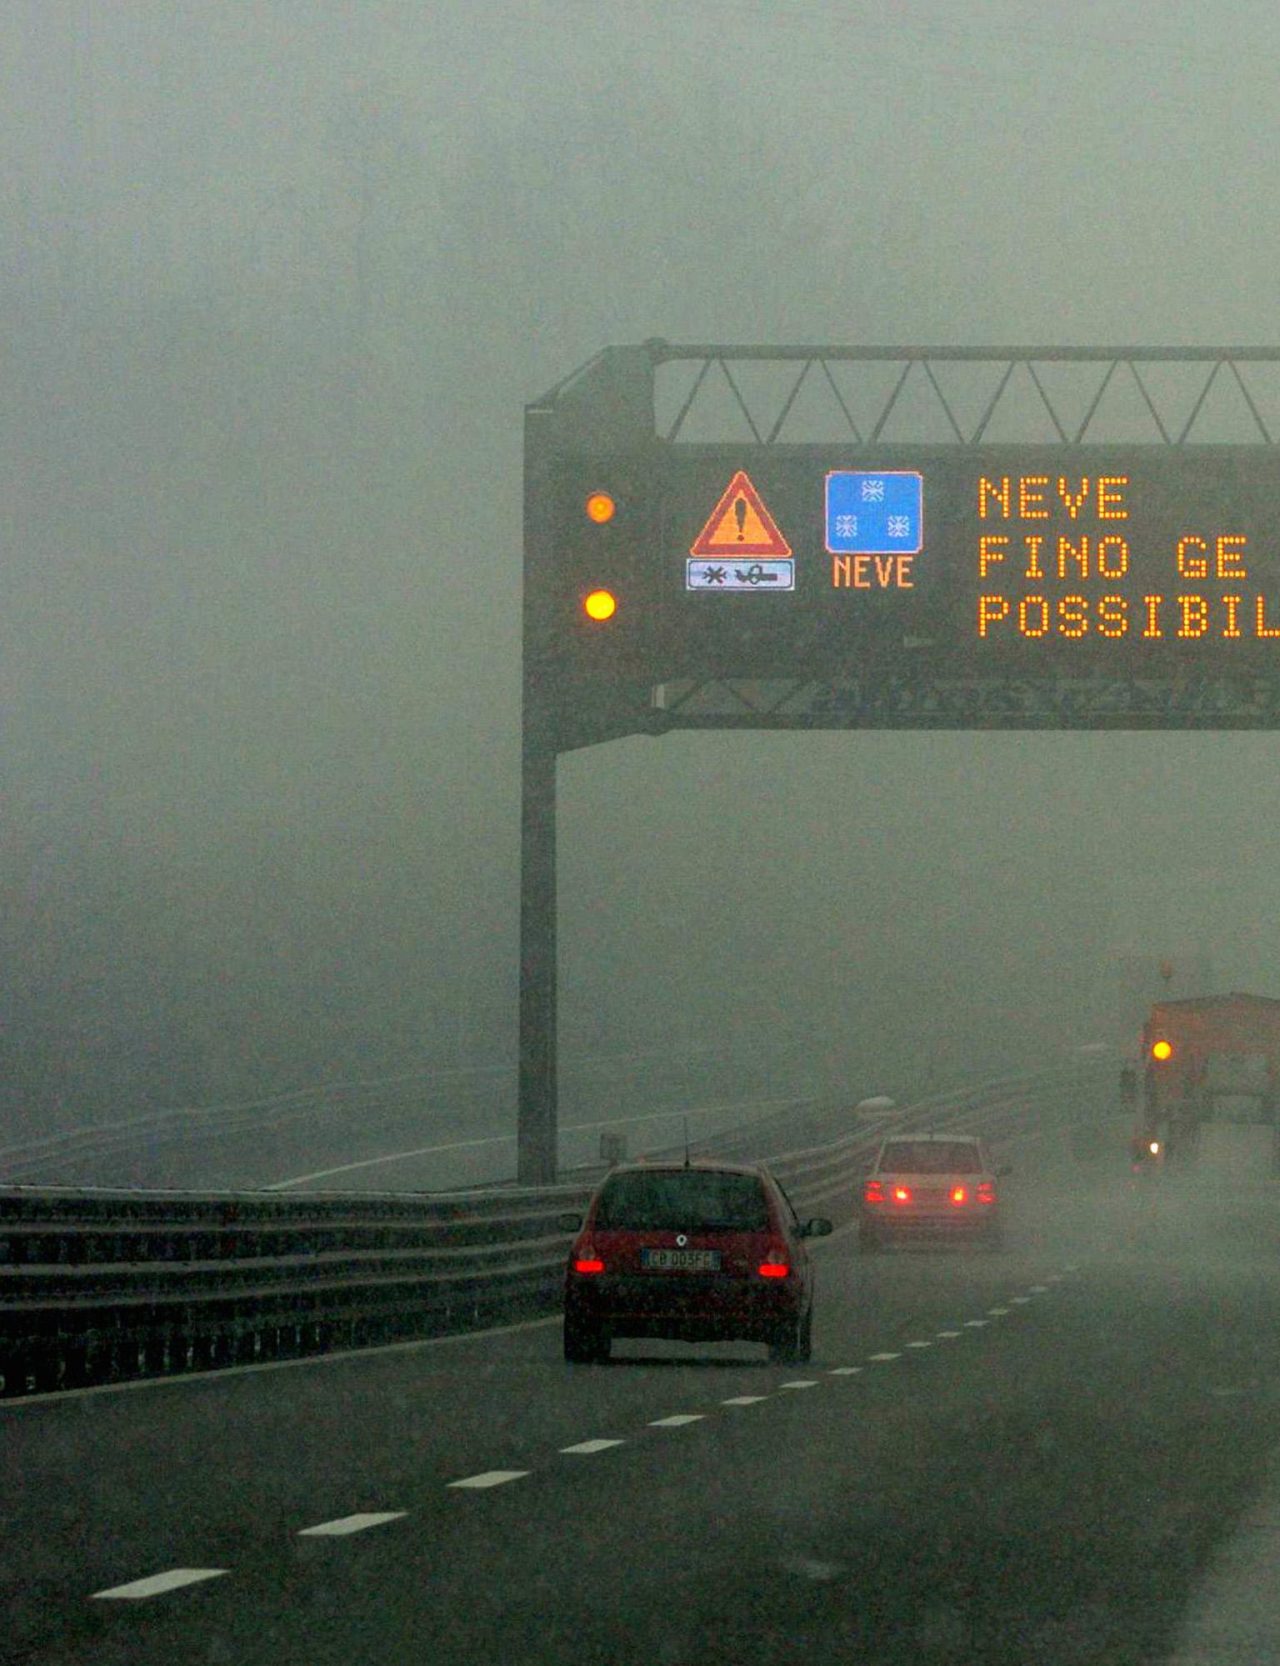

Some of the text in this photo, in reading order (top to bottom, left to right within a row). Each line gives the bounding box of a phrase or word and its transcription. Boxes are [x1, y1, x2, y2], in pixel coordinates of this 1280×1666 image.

[977, 475, 1129, 521] NEVE
[832, 554, 914, 589] NEVE
[978, 534, 1130, 580] FINO
[1175, 534, 1248, 580] GE
